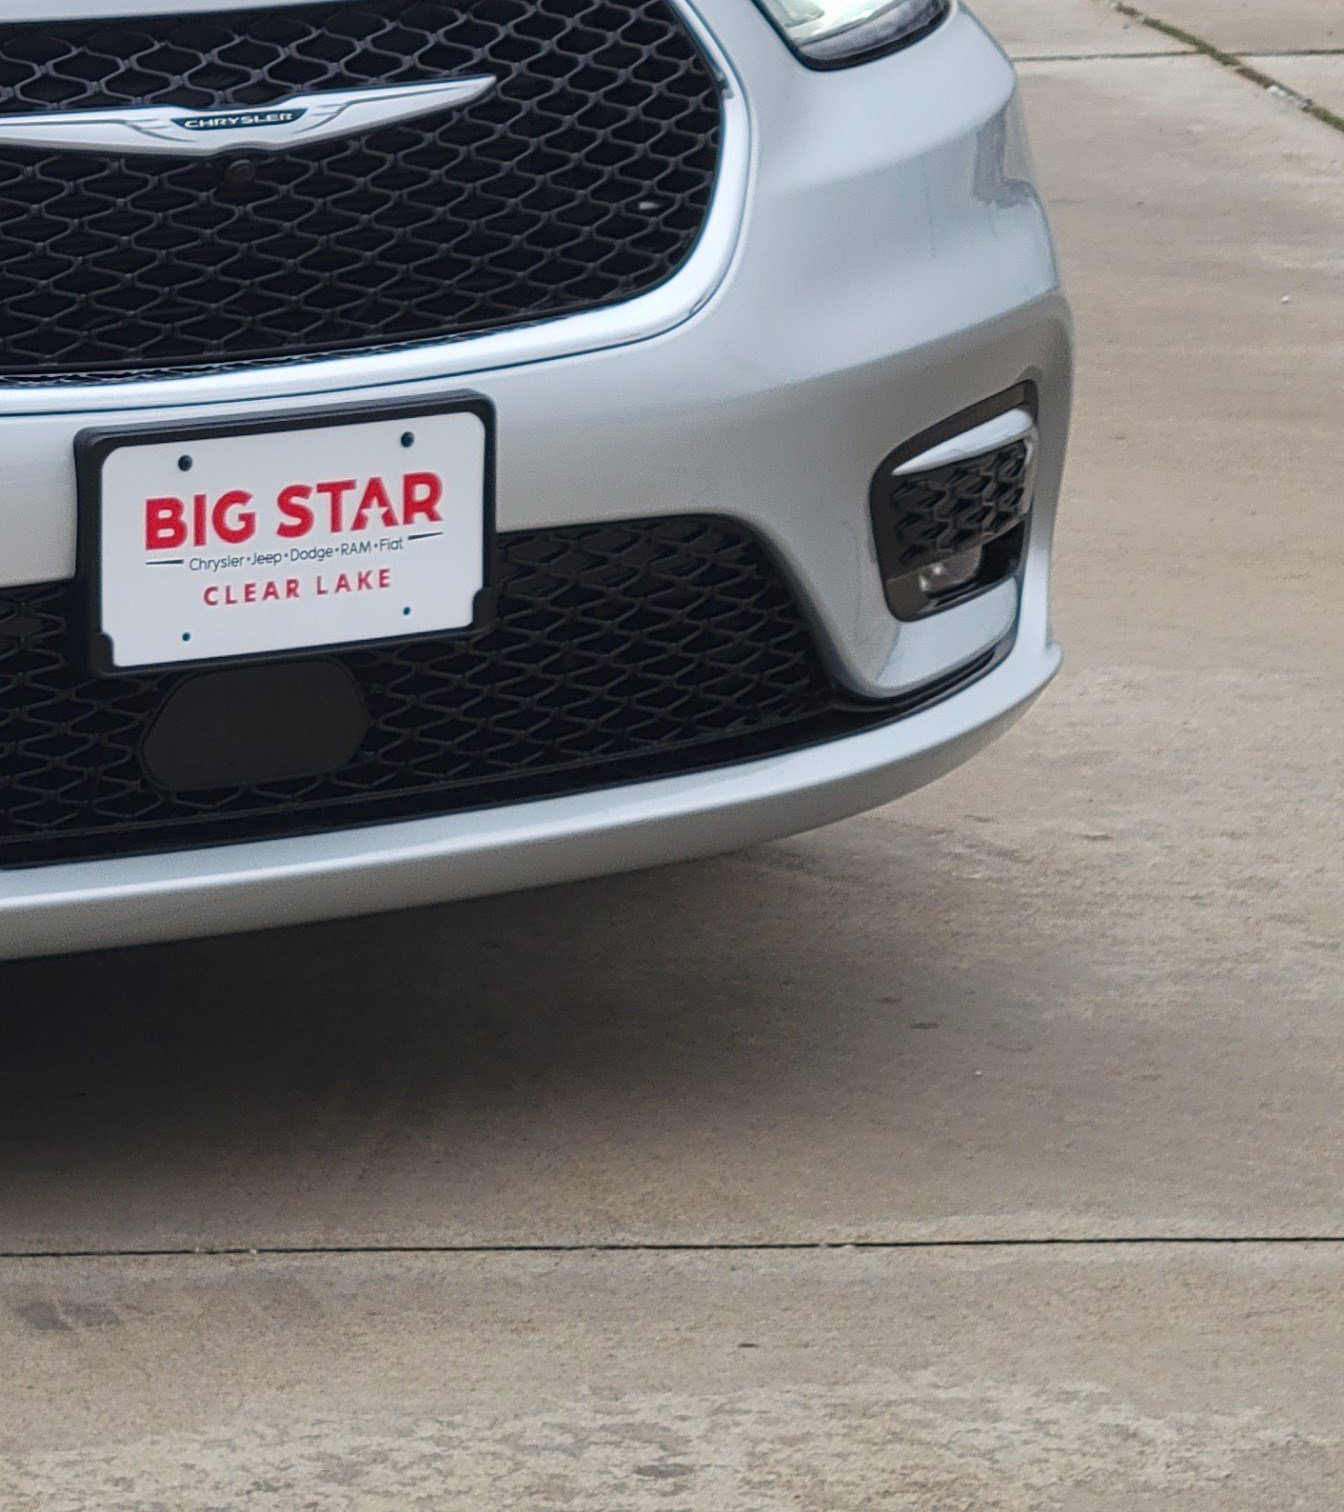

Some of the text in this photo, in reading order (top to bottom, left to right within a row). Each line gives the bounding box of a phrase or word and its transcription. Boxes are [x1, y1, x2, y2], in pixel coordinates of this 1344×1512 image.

[184, 112, 293, 128] CHRYSLER
[144, 471, 444, 551] BIG STAR
[189, 537, 404, 572] Chrysler Jeep Dodge RAM Fiat
[203, 568, 391, 606] CLEAR LAKE
